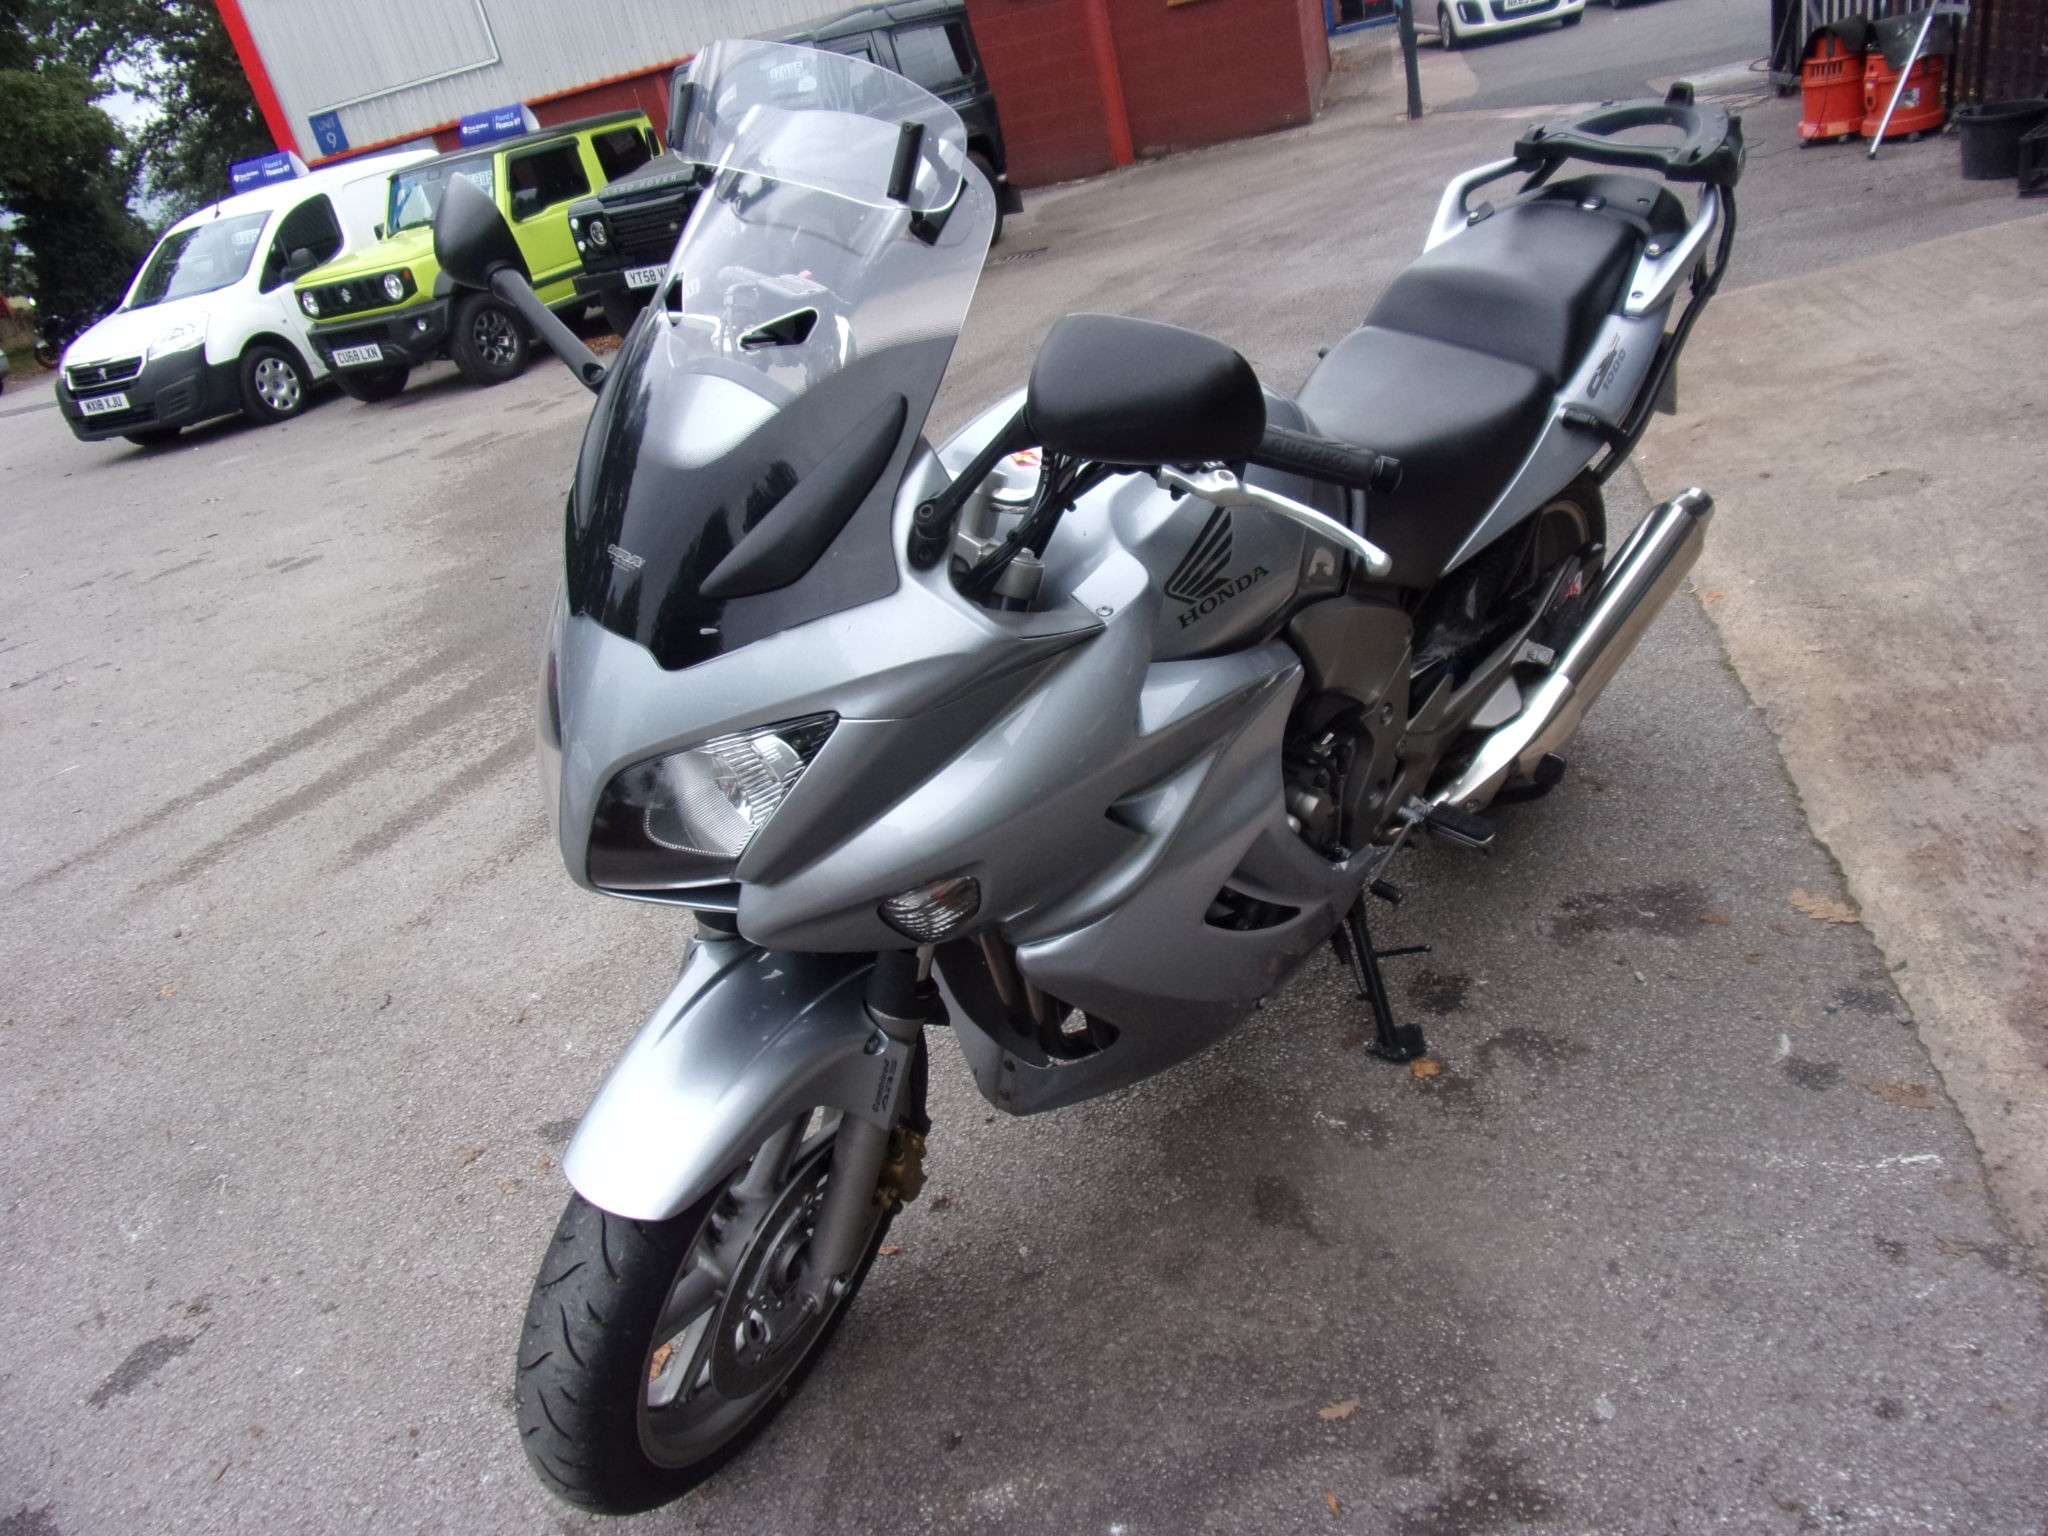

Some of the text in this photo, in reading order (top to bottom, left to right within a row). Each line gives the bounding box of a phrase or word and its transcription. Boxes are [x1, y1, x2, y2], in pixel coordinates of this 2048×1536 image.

[326, 132, 337, 149] 9
[630, 268, 657, 284] YT58
[1176, 565, 1269, 629] HONDA
